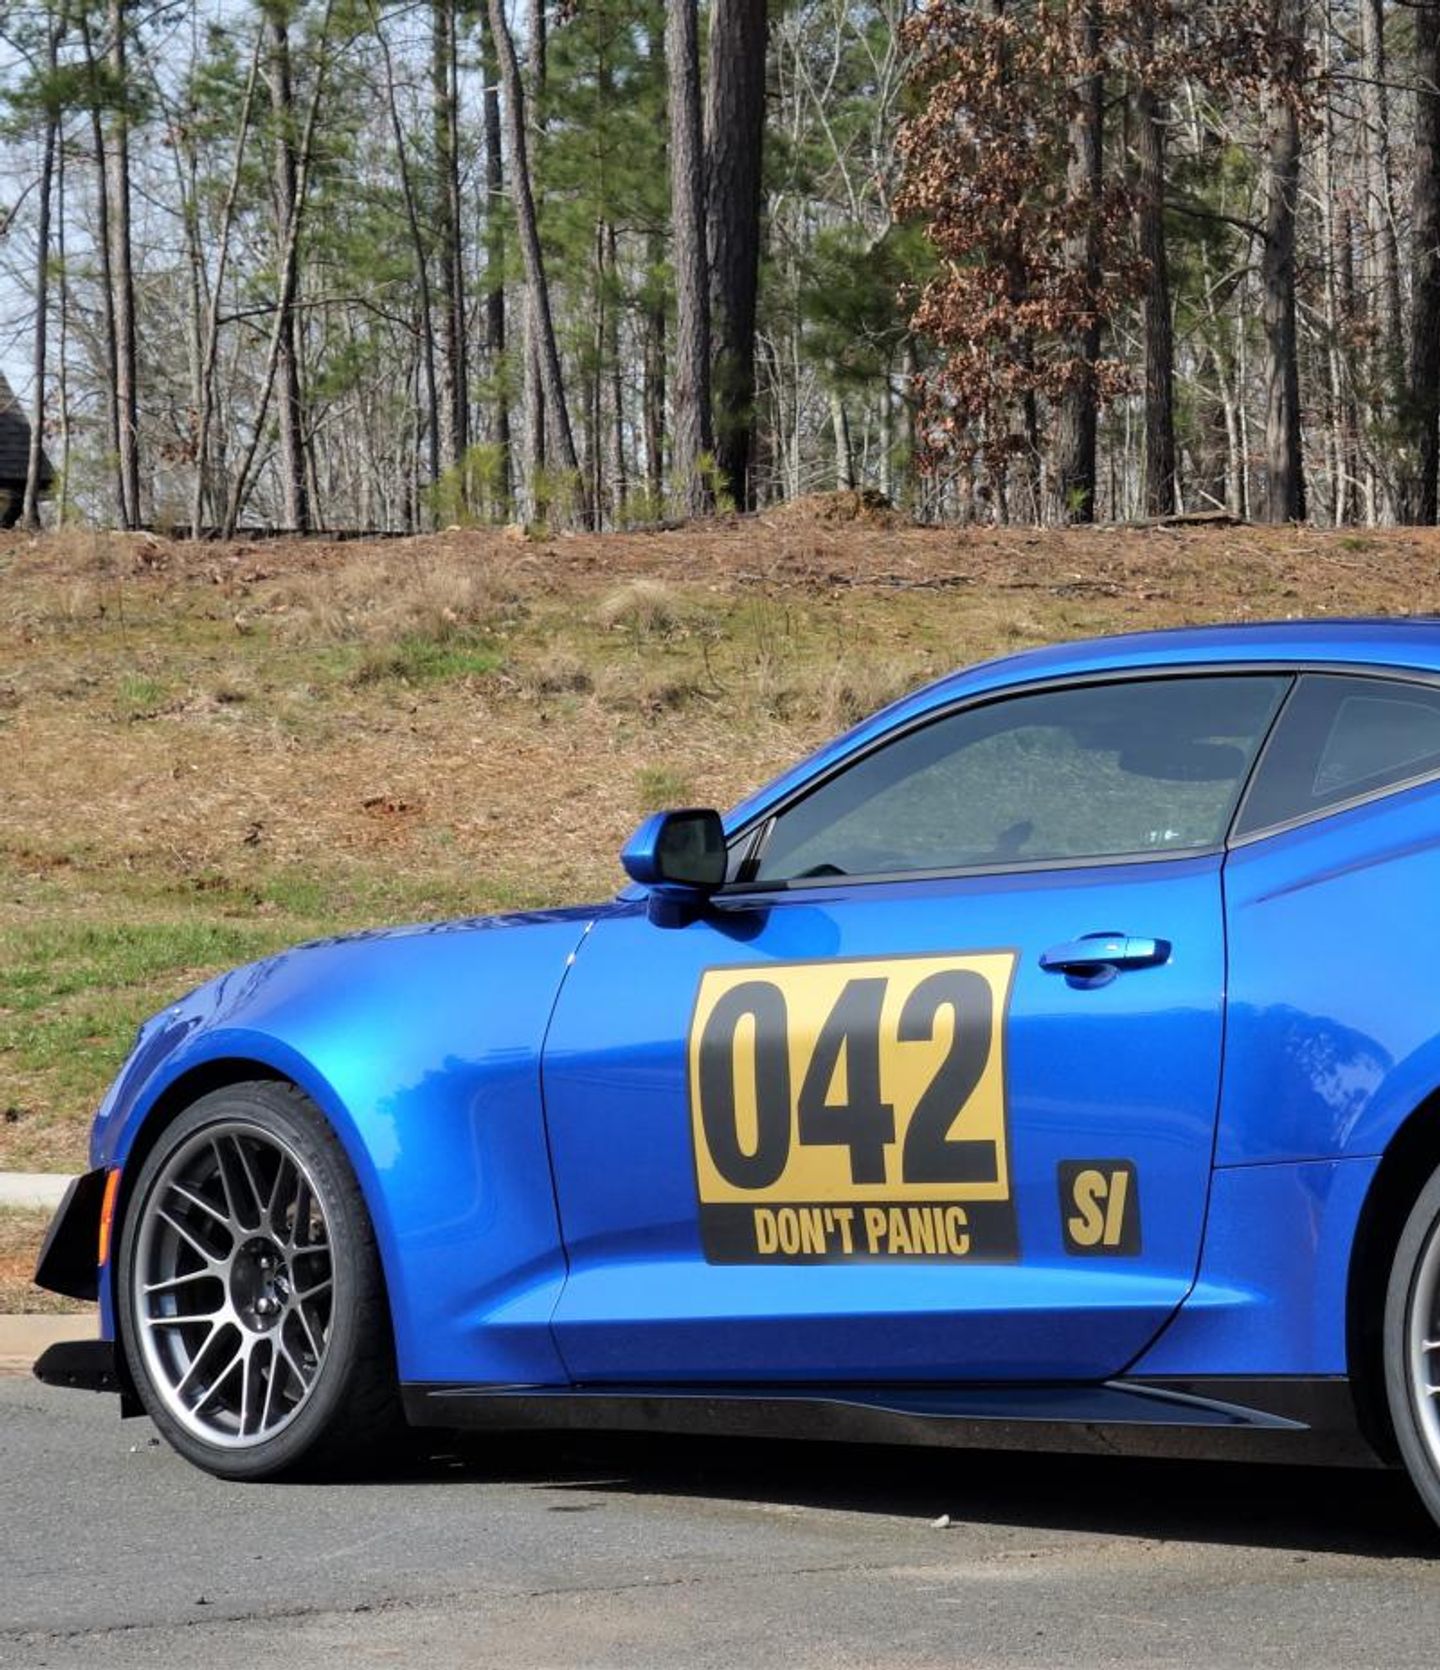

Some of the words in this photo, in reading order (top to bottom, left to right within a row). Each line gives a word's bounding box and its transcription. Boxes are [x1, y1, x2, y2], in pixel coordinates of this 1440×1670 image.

[699, 968, 999, 1190] 042
[753, 1207, 854, 1255] DON'T
[863, 1206, 970, 1255] PANIC
